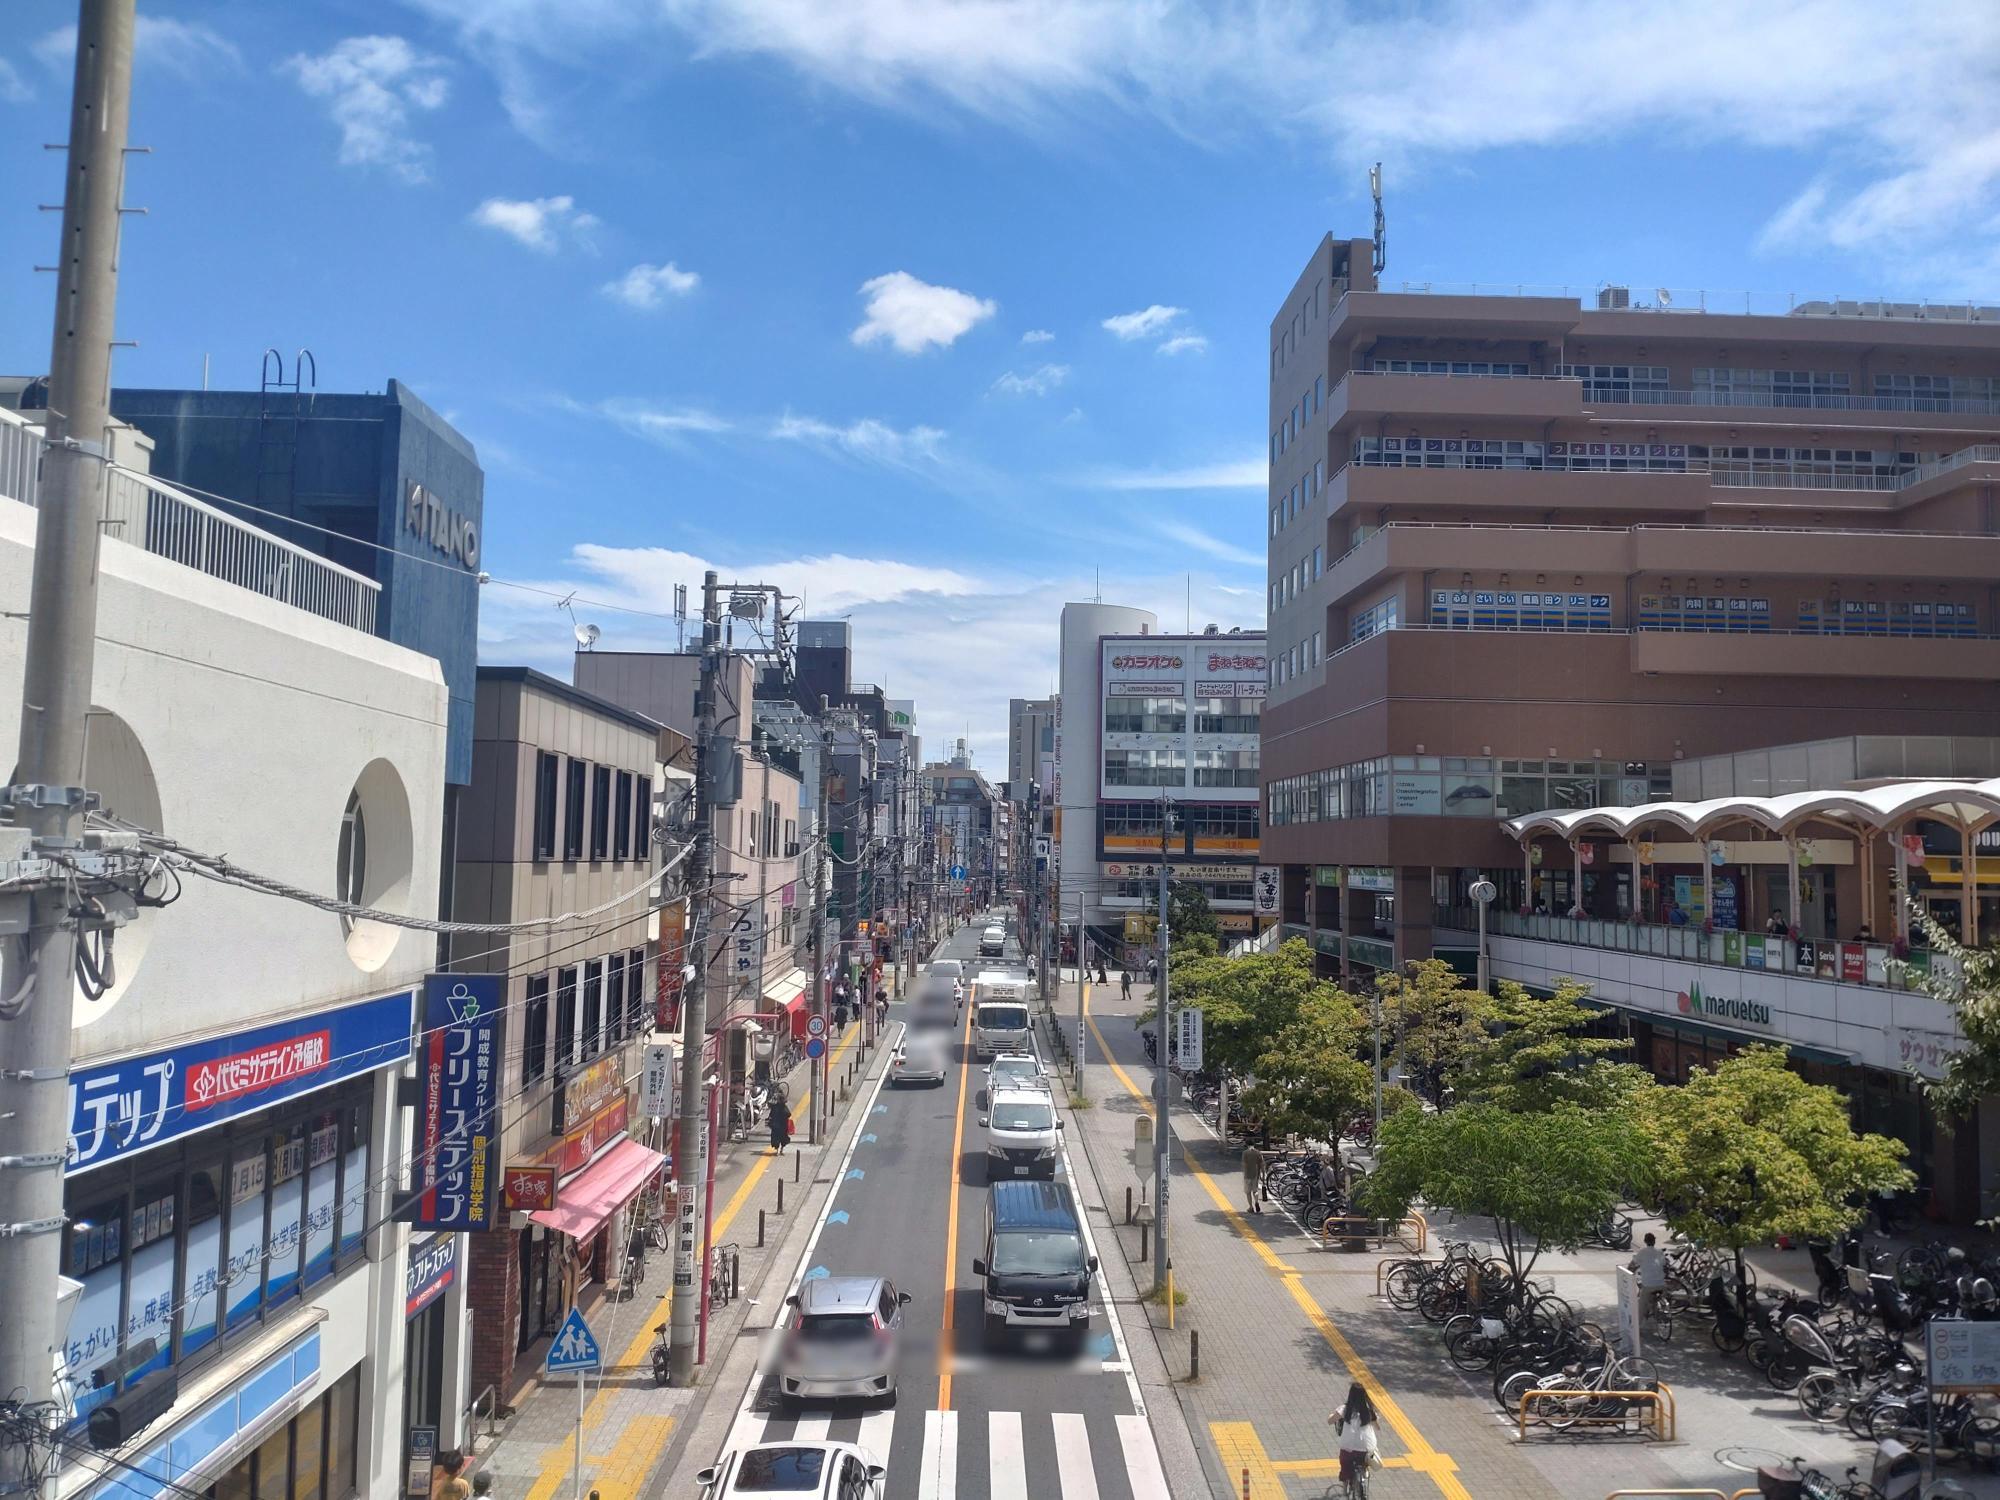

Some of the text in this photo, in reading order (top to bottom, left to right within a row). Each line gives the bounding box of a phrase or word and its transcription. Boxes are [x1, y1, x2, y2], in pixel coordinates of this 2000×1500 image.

[404, 477, 478, 568] KITANO
[1818, 950, 1835, 961] Seria
[811, 1021, 822, 1031] 30
[1705, 994, 1770, 1025] maruetsu
[215, 1037, 324, 1095] 代ゼミサテライン予備校
[474, 1028, 491, 1132] 開成教育グループ
[440, 1028, 471, 1222] フリーステップ
[468, 1136, 487, 1222] 個別指導学院
[512, 1172, 547, 1197] すき家
[414, 1236, 455, 1289] フリーステップ
